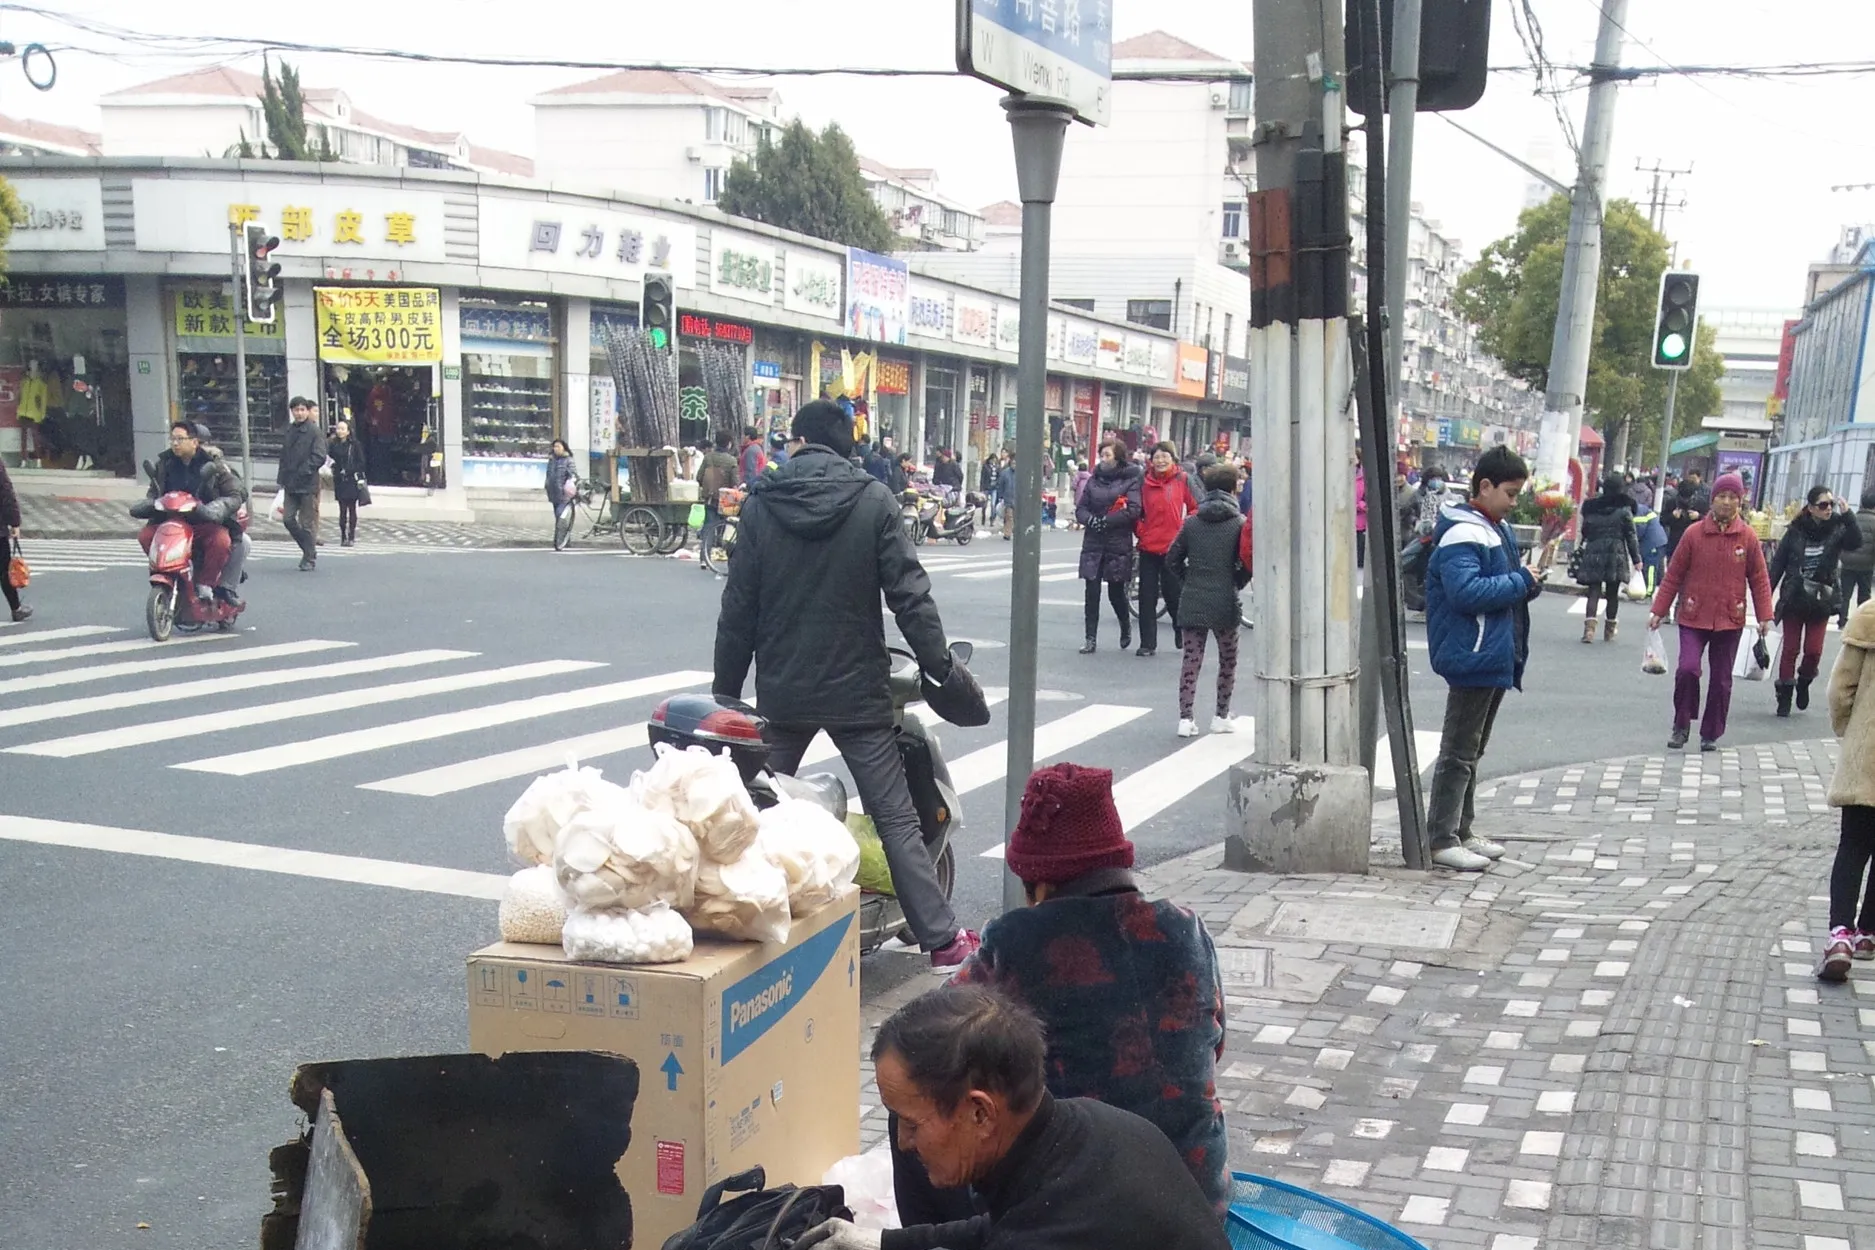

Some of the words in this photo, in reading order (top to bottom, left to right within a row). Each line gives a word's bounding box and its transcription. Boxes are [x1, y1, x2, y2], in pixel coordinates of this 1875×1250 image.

[981, 30, 994, 64] W
[1057, 66, 1071, 97] Rd
[529, 220, 671, 267] 回力鞋业
[384, 292, 437, 308] 美国品牌
[329, 311, 434, 326] 牛皮高帮男皮鞋
[323, 325, 434, 351] 全场300元
[680, 386, 708, 420] 茶
[730, 969, 793, 1034] Panasonic
